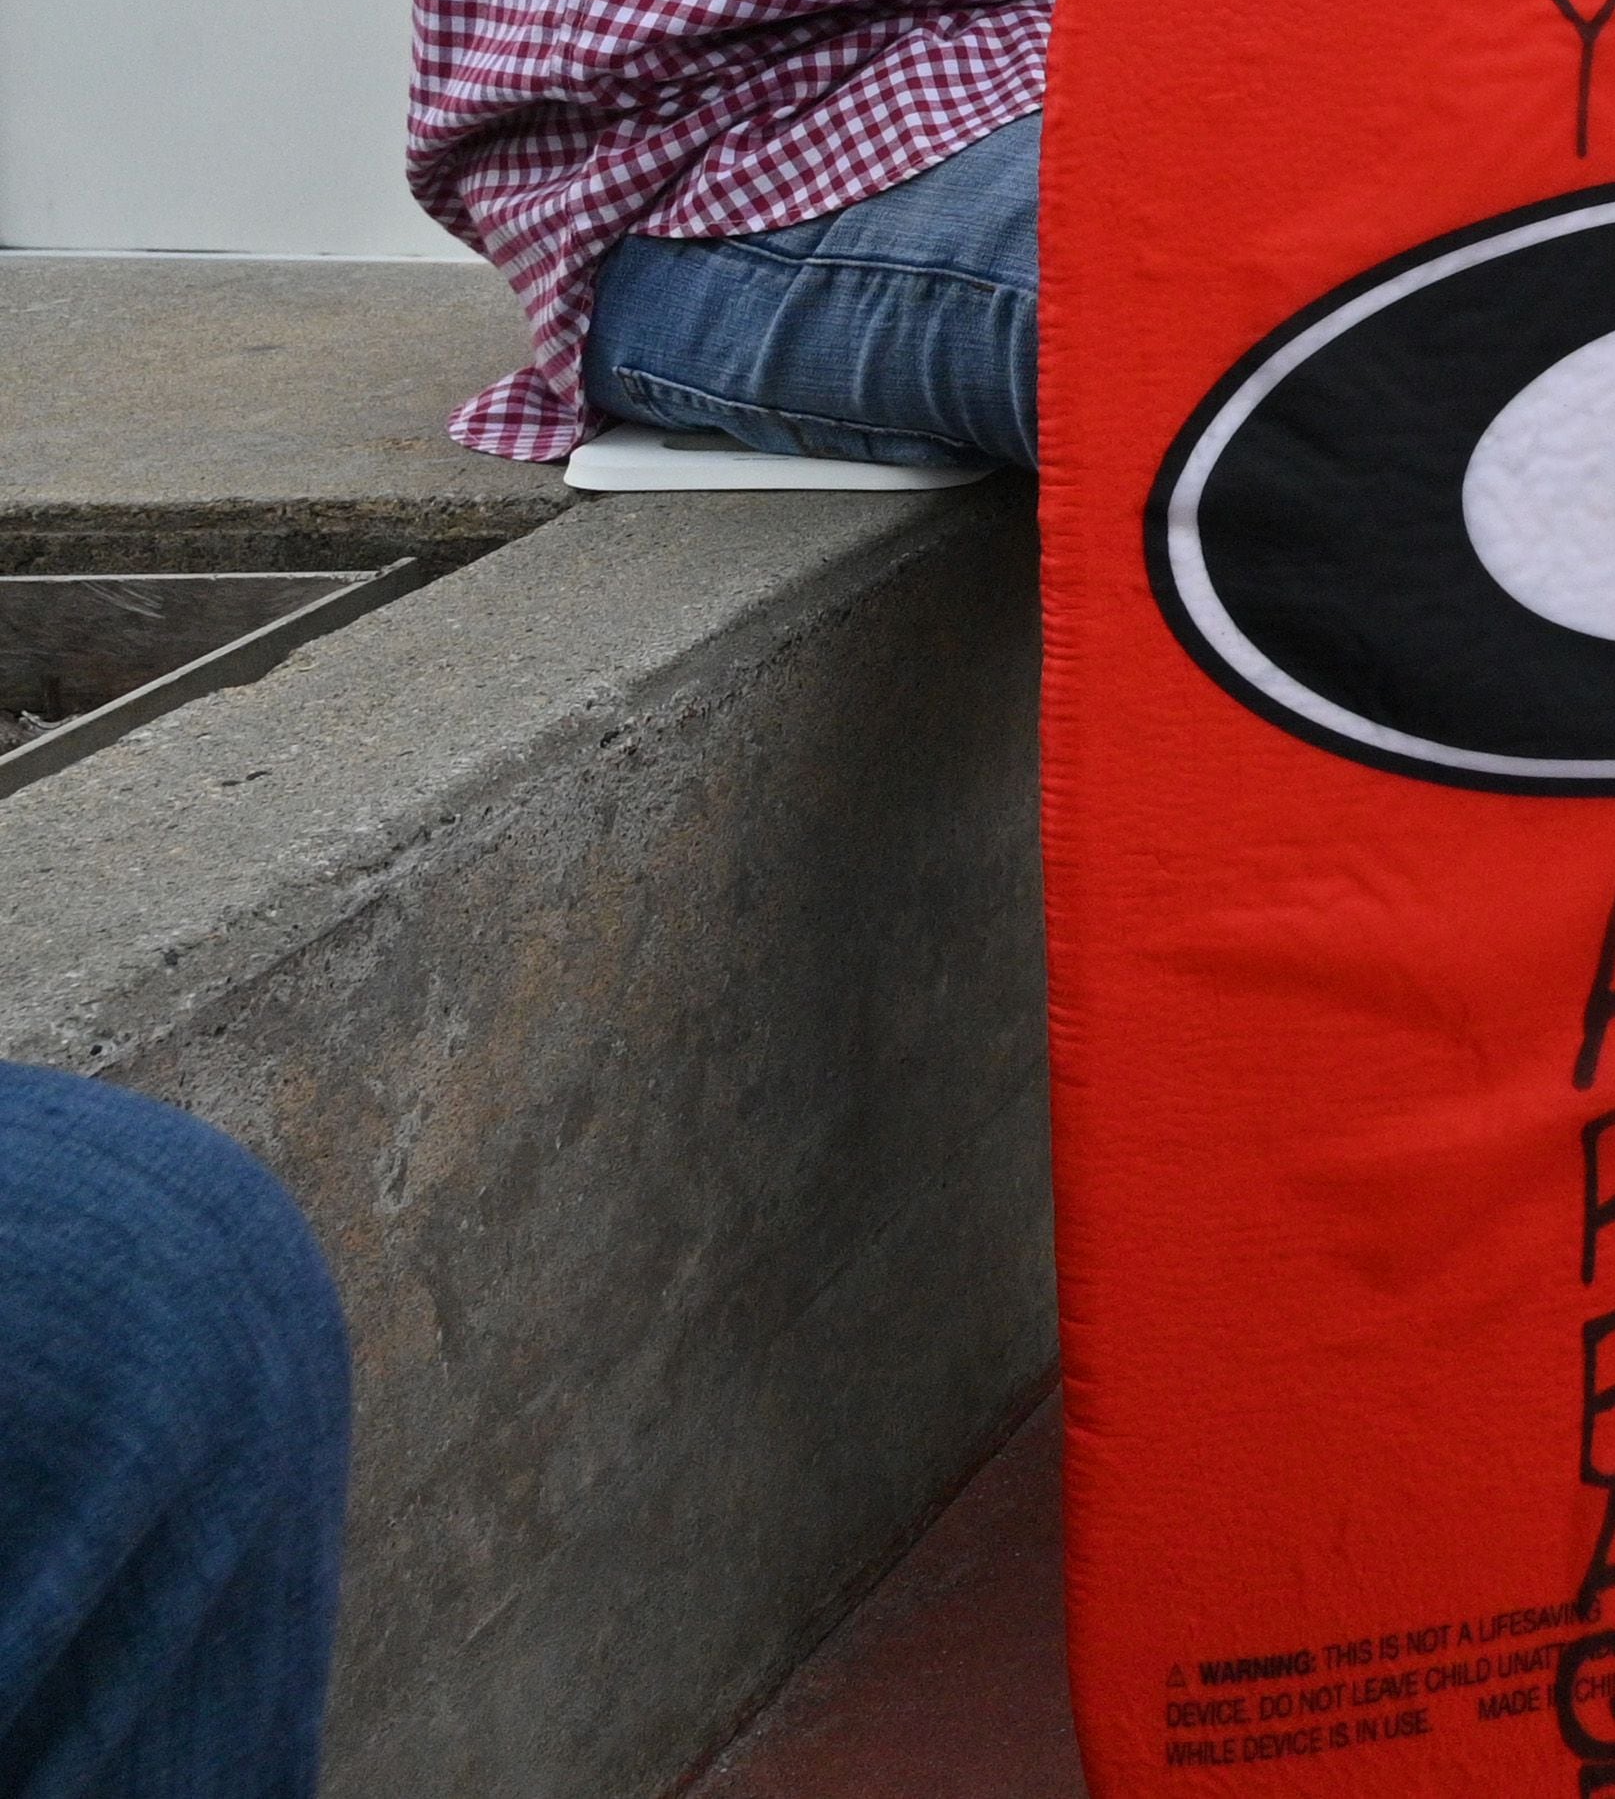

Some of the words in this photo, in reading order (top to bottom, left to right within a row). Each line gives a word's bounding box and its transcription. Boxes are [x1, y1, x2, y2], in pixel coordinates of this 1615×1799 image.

[1200, 1649, 1316, 1686] WARNING:
[1324, 1638, 1373, 1669] THIS
[1379, 1634, 1399, 1660] IS
[1407, 1624, 1451, 1655] NOT
[1457, 1621, 1473, 1647] A
[1259, 1692, 1293, 1721] DO
[1300, 1683, 1346, 1714] NOT
[1353, 1670, 1420, 1707] LEAVE
[1425, 1656, 1491, 1693] CHILD
[1478, 1686, 1541, 1721] MADE
[1166, 1738, 1236, 1767] WHILE
[1243, 1726, 1323, 1764] DEVICE
[1329, 1722, 1350, 1749] IS
[1356, 1717, 1378, 1744] IN
